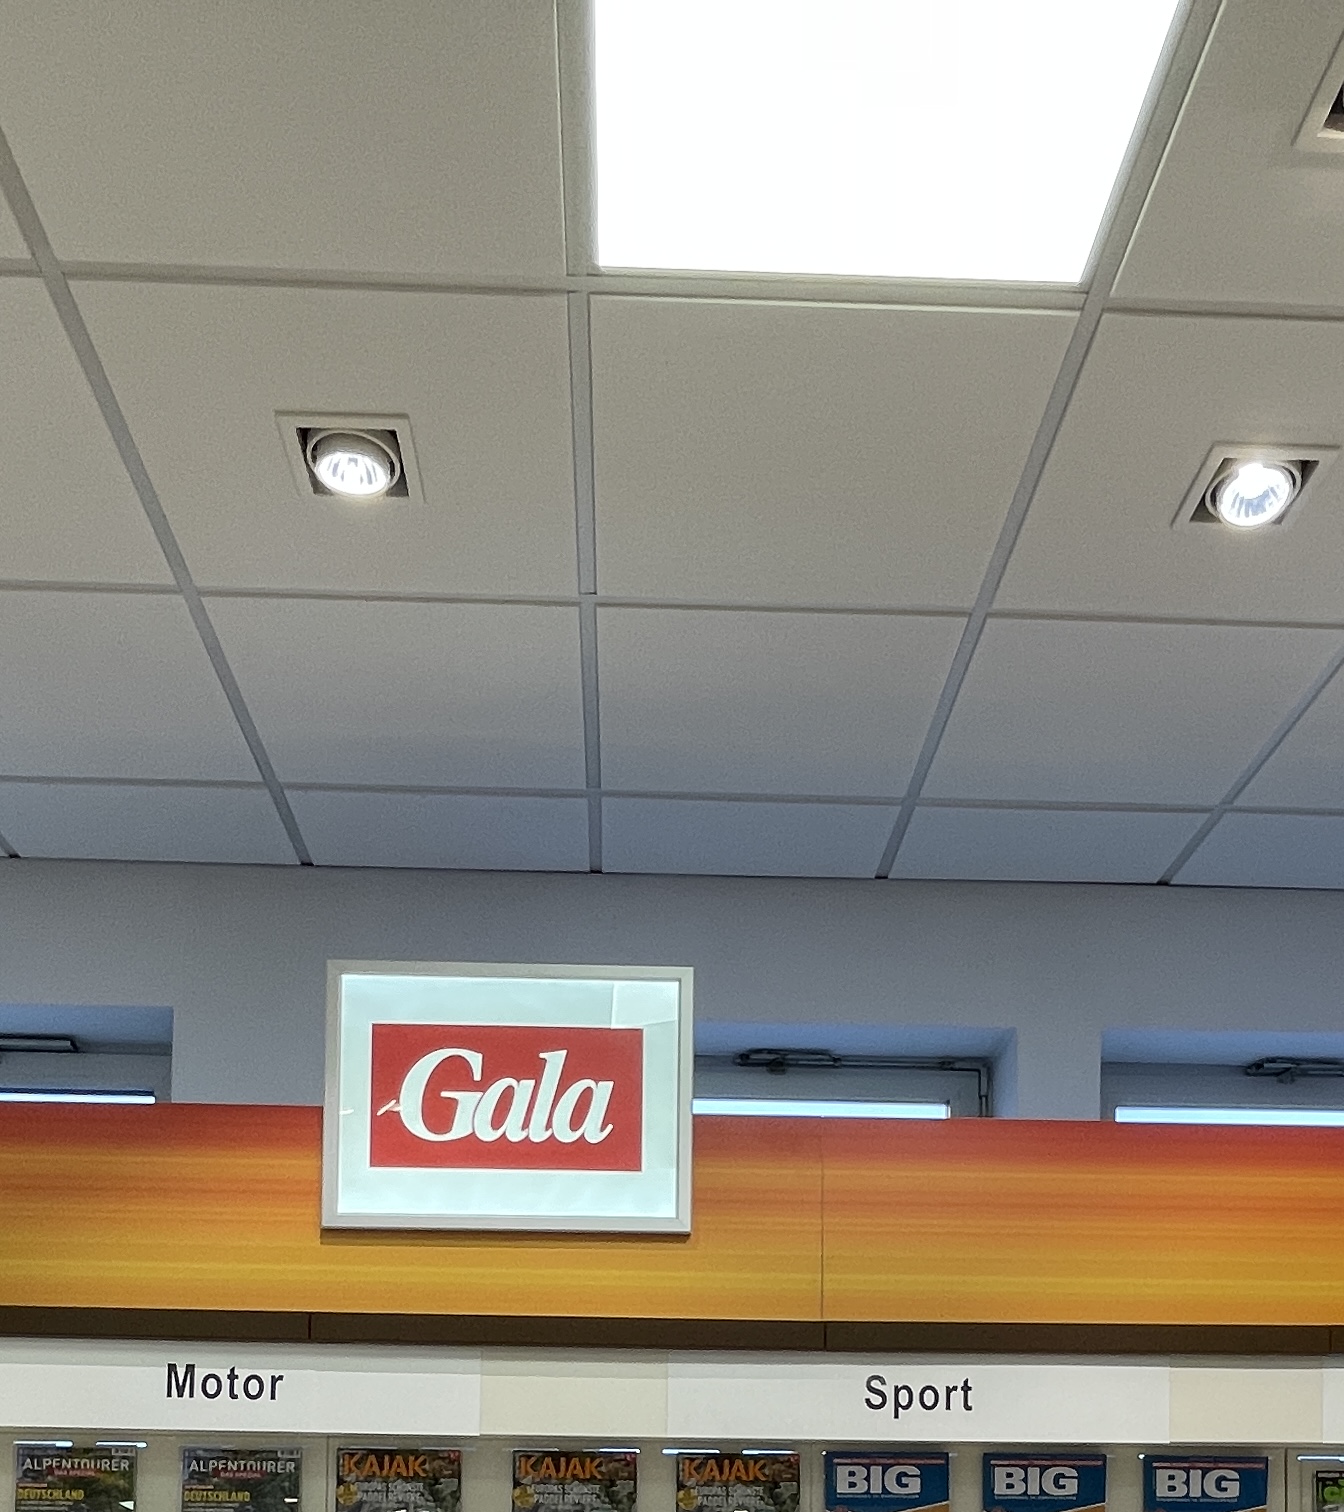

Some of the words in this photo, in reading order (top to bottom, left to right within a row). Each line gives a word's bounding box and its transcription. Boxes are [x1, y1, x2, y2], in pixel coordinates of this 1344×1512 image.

[378, 1048, 615, 1145] Gala
[166, 1363, 284, 1401] Motor
[865, 1377, 973, 1417] Sport
[519, 1456, 602, 1479] KAJAK
[683, 1458, 766, 1480] KAJAK
[836, 1466, 921, 1494] BIG
[994, 1466, 1078, 1495] BIG
[1157, 1469, 1240, 1498] BIG
